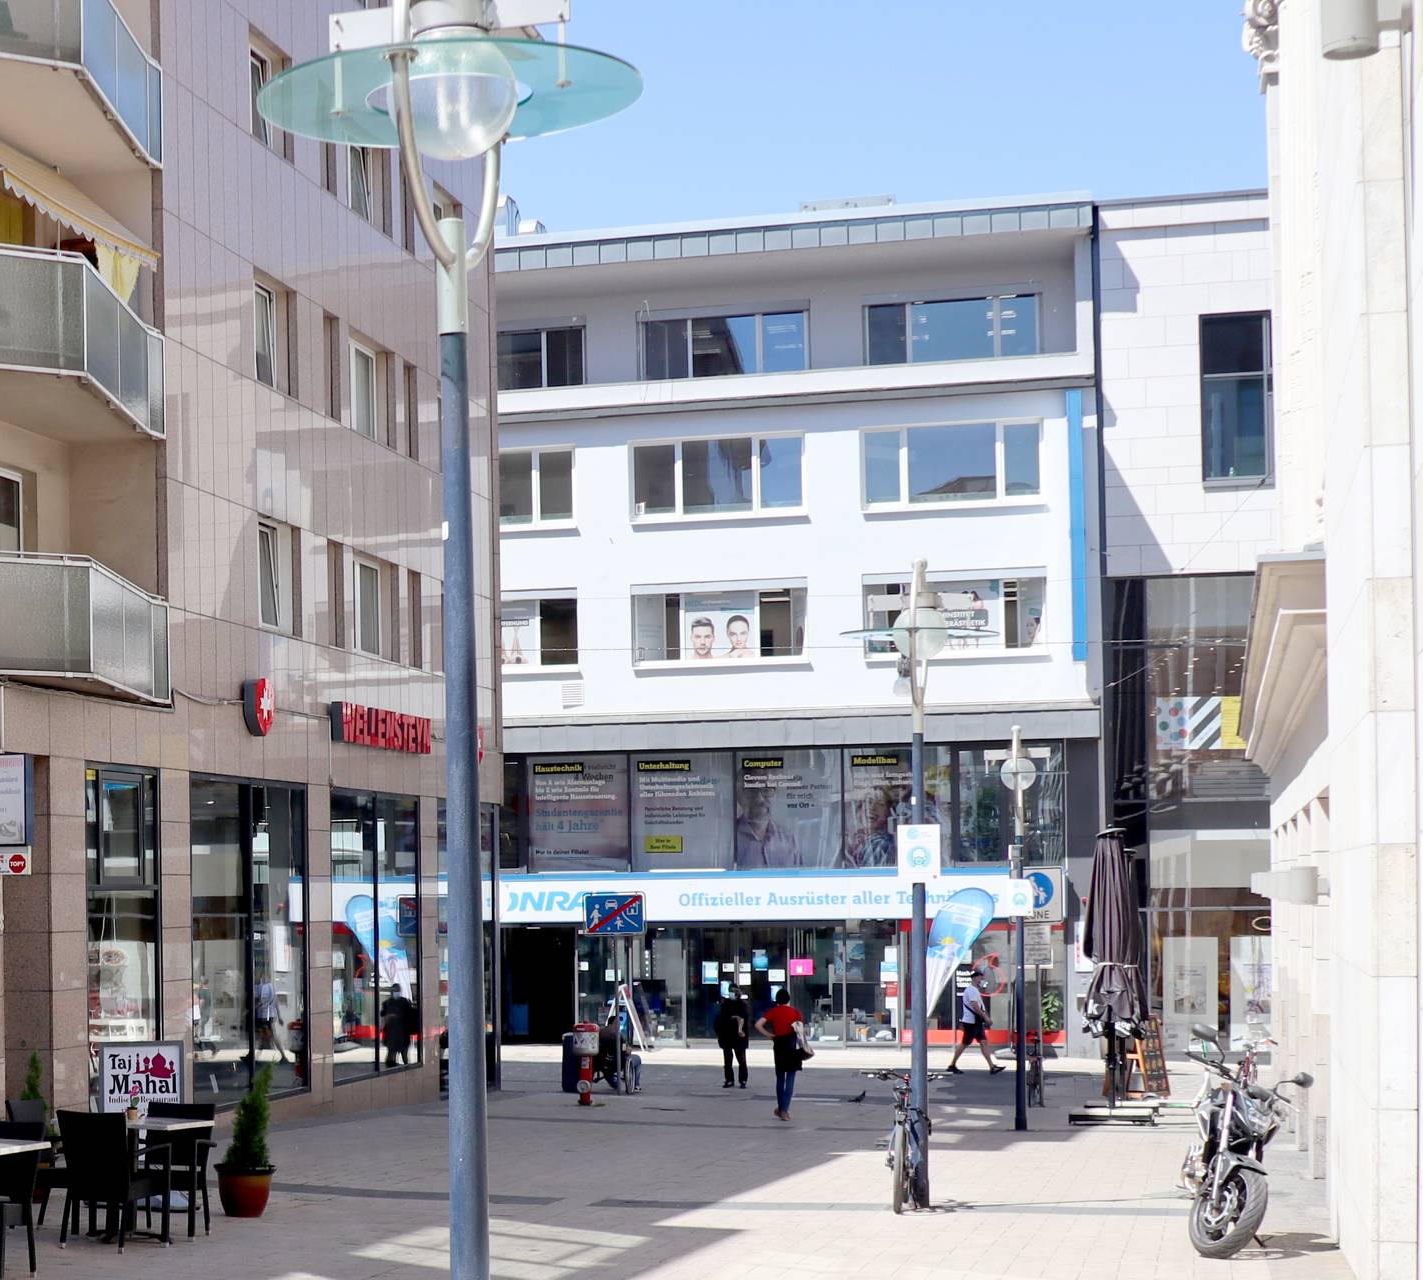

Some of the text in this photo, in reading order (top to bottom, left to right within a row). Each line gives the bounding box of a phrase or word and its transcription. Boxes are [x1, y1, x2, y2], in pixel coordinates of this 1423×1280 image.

[341, 702, 431, 754] WELLENSTEYN
[535, 764, 582, 773] Haustechnik
[639, 762, 689, 770] Unterhaltung
[744, 760, 782, 768] Computer
[678, 892, 761, 907] Offizieller
[767, 891, 847, 906] Ausrüster
[852, 890, 890, 905] aller
[108, 1054, 132, 1073] Taj
[108, 1072, 177, 1095] Mahal
